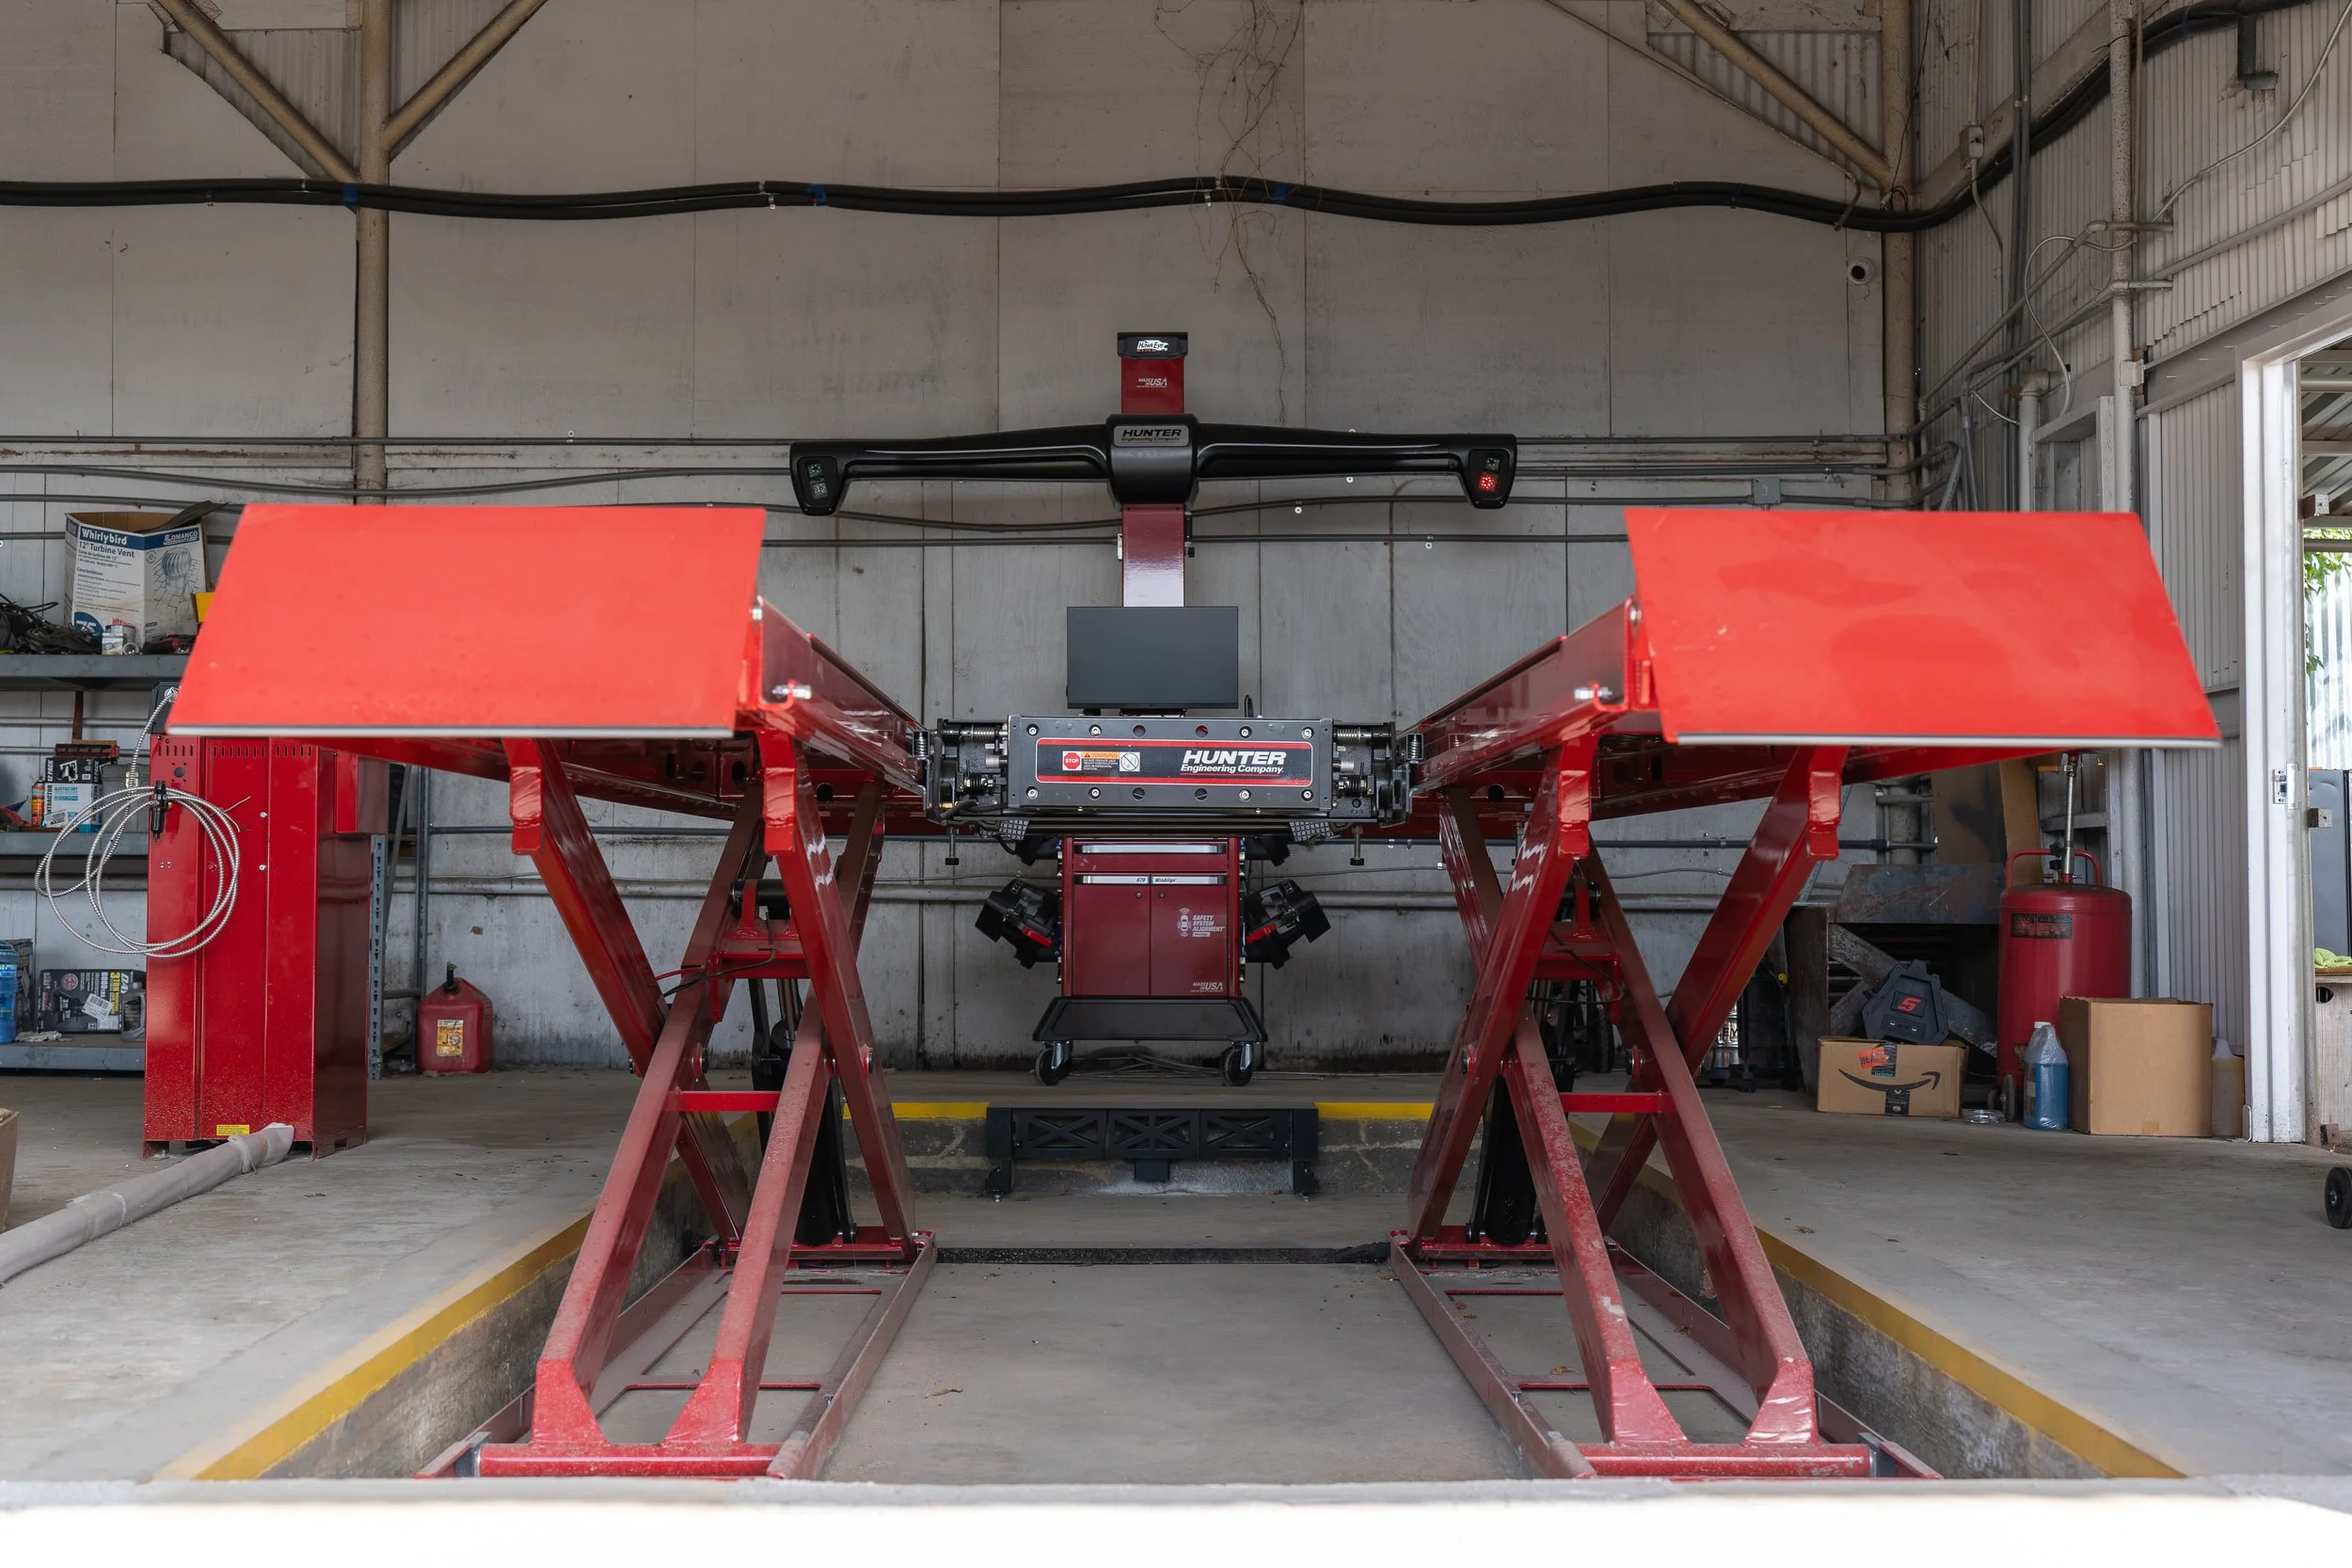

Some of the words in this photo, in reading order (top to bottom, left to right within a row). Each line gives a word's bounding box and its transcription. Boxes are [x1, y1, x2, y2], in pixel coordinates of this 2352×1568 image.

[1150, 377, 1168, 386] USA
[82, 528, 128, 546] Whirlybird
[165, 531, 198, 541] LOMANCO
[89, 543, 116, 555] Turbine
[118, 548, 135, 558] Vent
[1183, 750, 1287, 765] HUNTER
[1181, 764, 1236, 774] Engineering
[1205, 981, 1223, 990] USA
